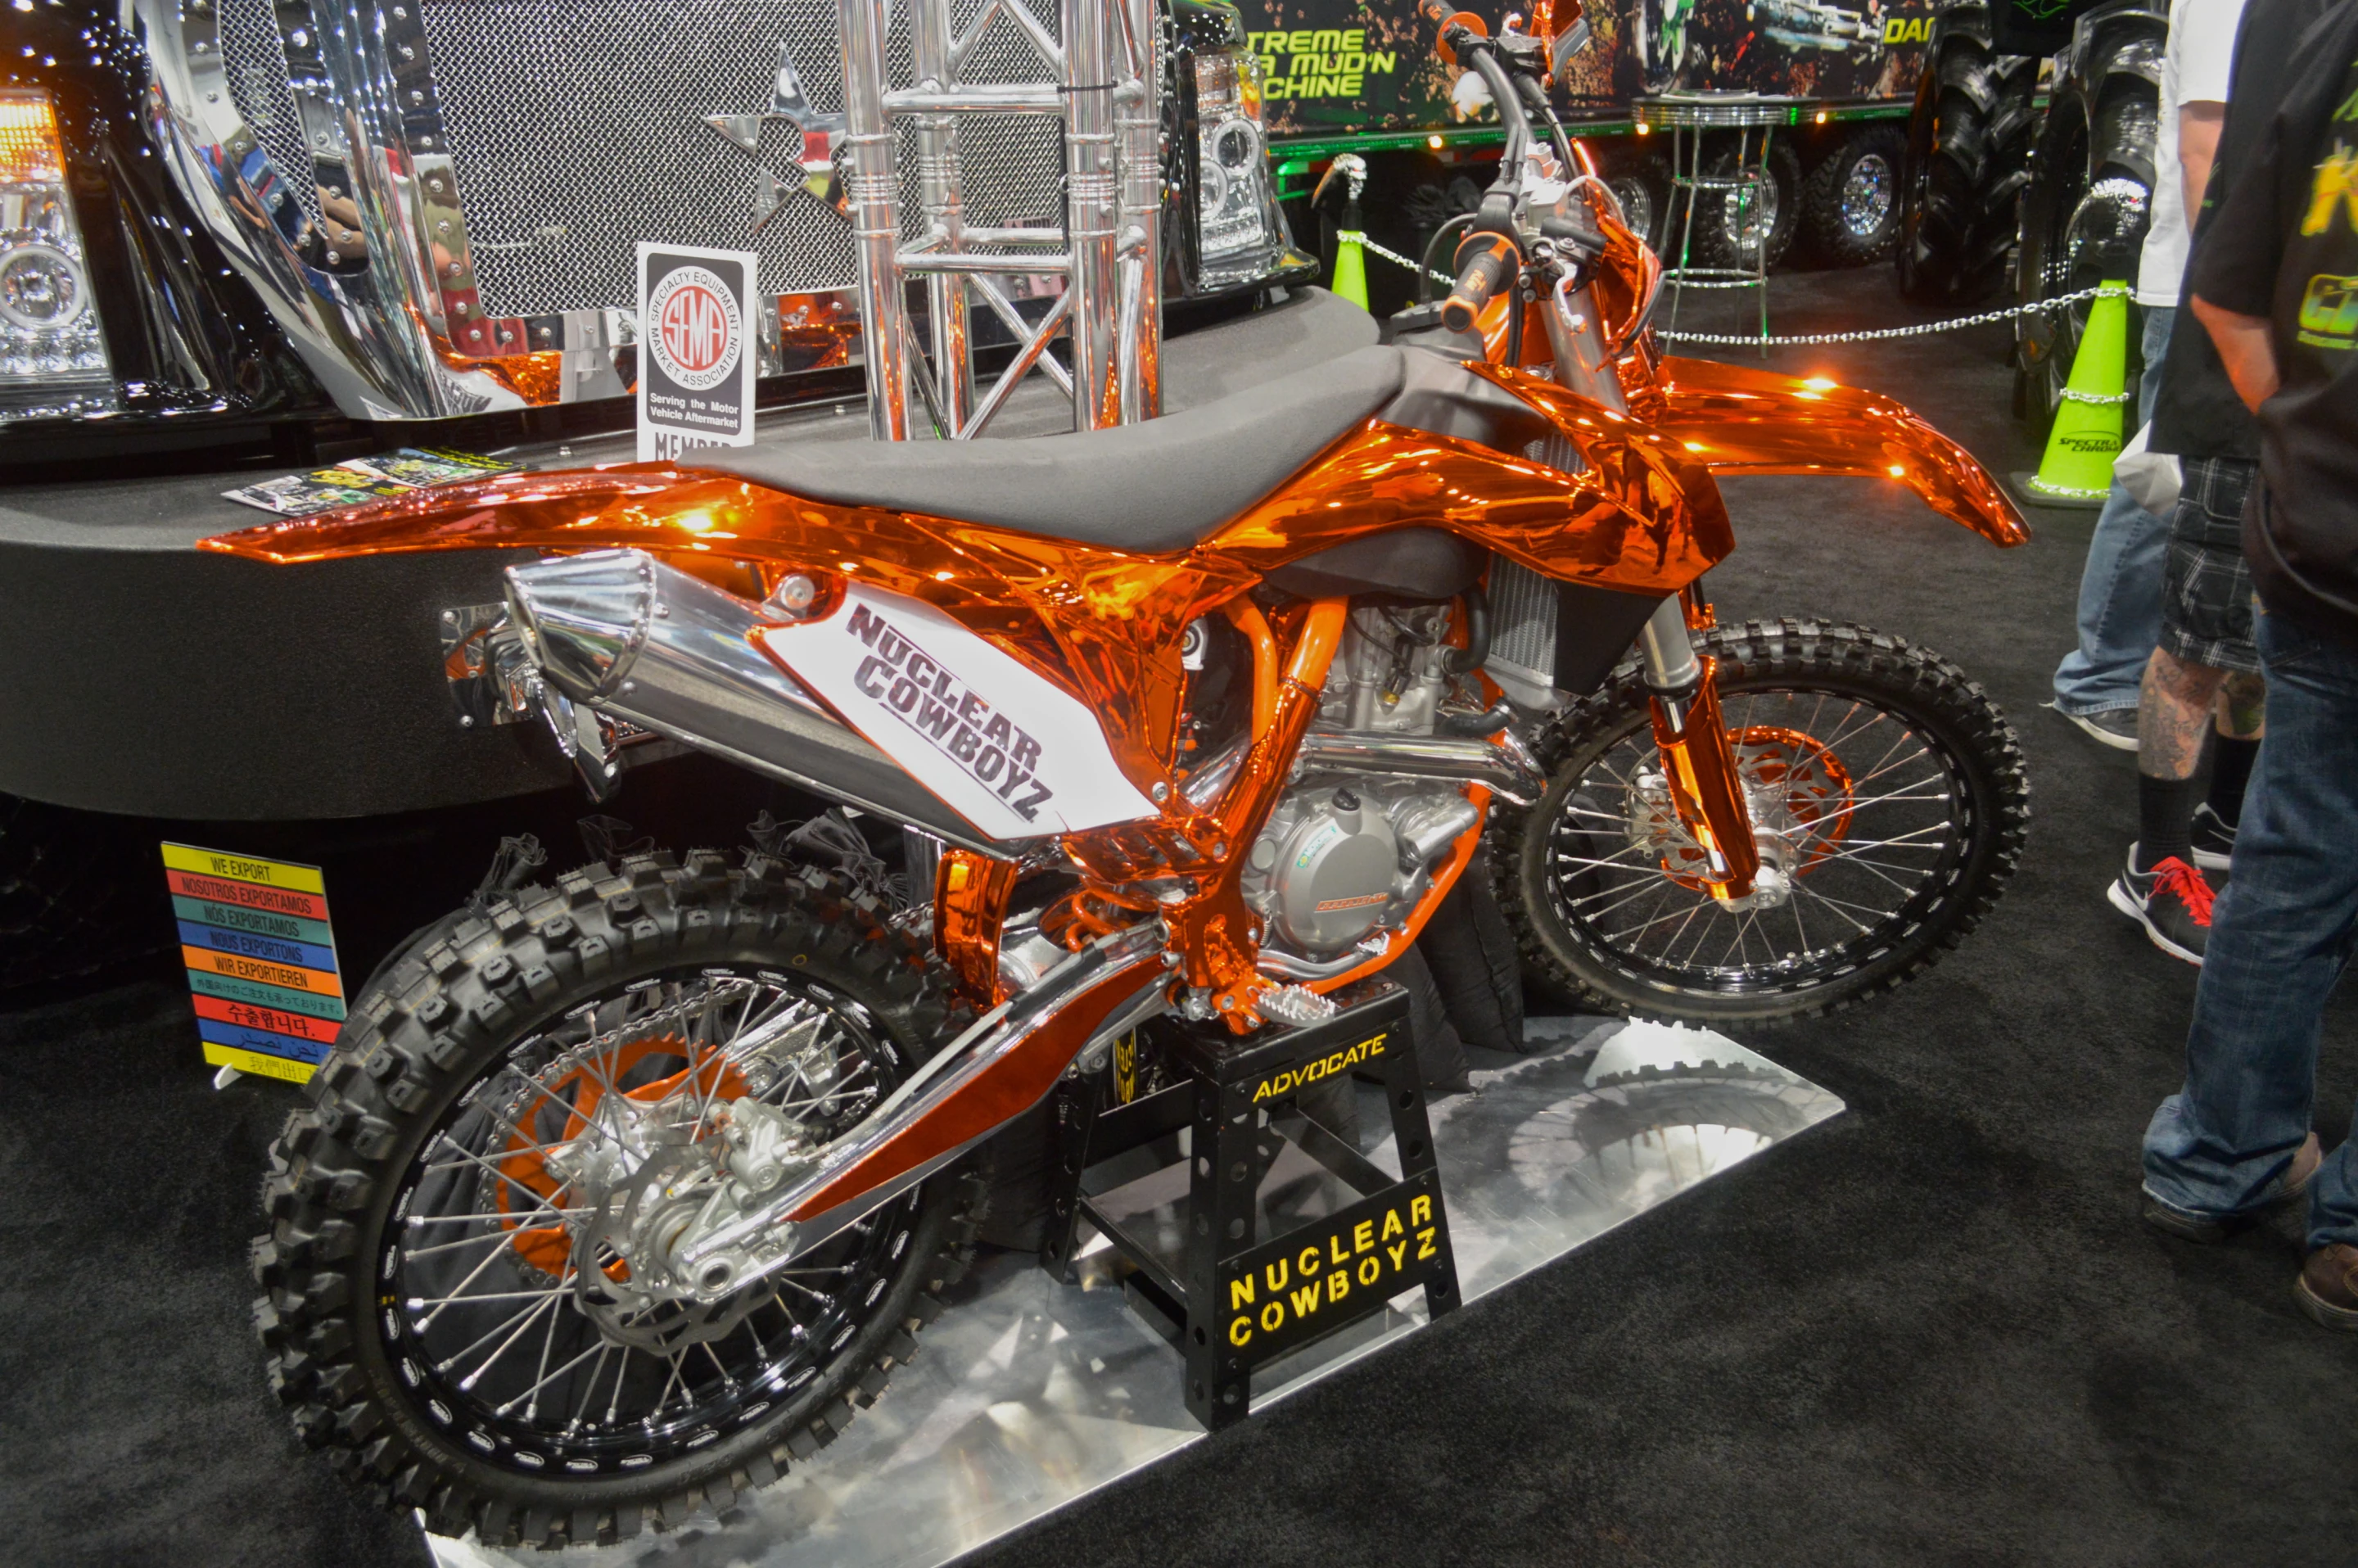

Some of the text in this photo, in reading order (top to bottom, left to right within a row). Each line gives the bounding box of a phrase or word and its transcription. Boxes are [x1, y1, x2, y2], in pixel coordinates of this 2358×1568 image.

[1290, 51, 1397, 76] MUD'N
[651, 272, 739, 332] SPECIALTY EQUIPMENT
[665, 289, 725, 367] SEMA
[651, 328, 739, 386] MARKET ASSOCIATION
[650, 392, 739, 414] Serving the Motor
[650, 406, 739, 428] Vehicle Aftermarket
[655, 432, 733, 461] MEM
[845, 602, 1042, 772] NUCLEAR
[853, 654, 1054, 821] COWBOYZ
[210, 856, 270, 881] WE EXPORT
[182, 877, 312, 915] NOSOTROS EXPORTAMOS
[204, 903, 300, 937] NÓS EXPORTAMOS
[210, 931, 303, 962] NOUS EXPORTONS
[214, 956, 308, 987] WIR EXPORTIEREN
[228, 1004, 315, 1037] 수출합니다.
[1252, 1033, 1388, 1103] ADVOCATE
[1231, 1194, 1432, 1310] NUCLEAR
[1229, 1227, 1437, 1347] COWBOYZ
